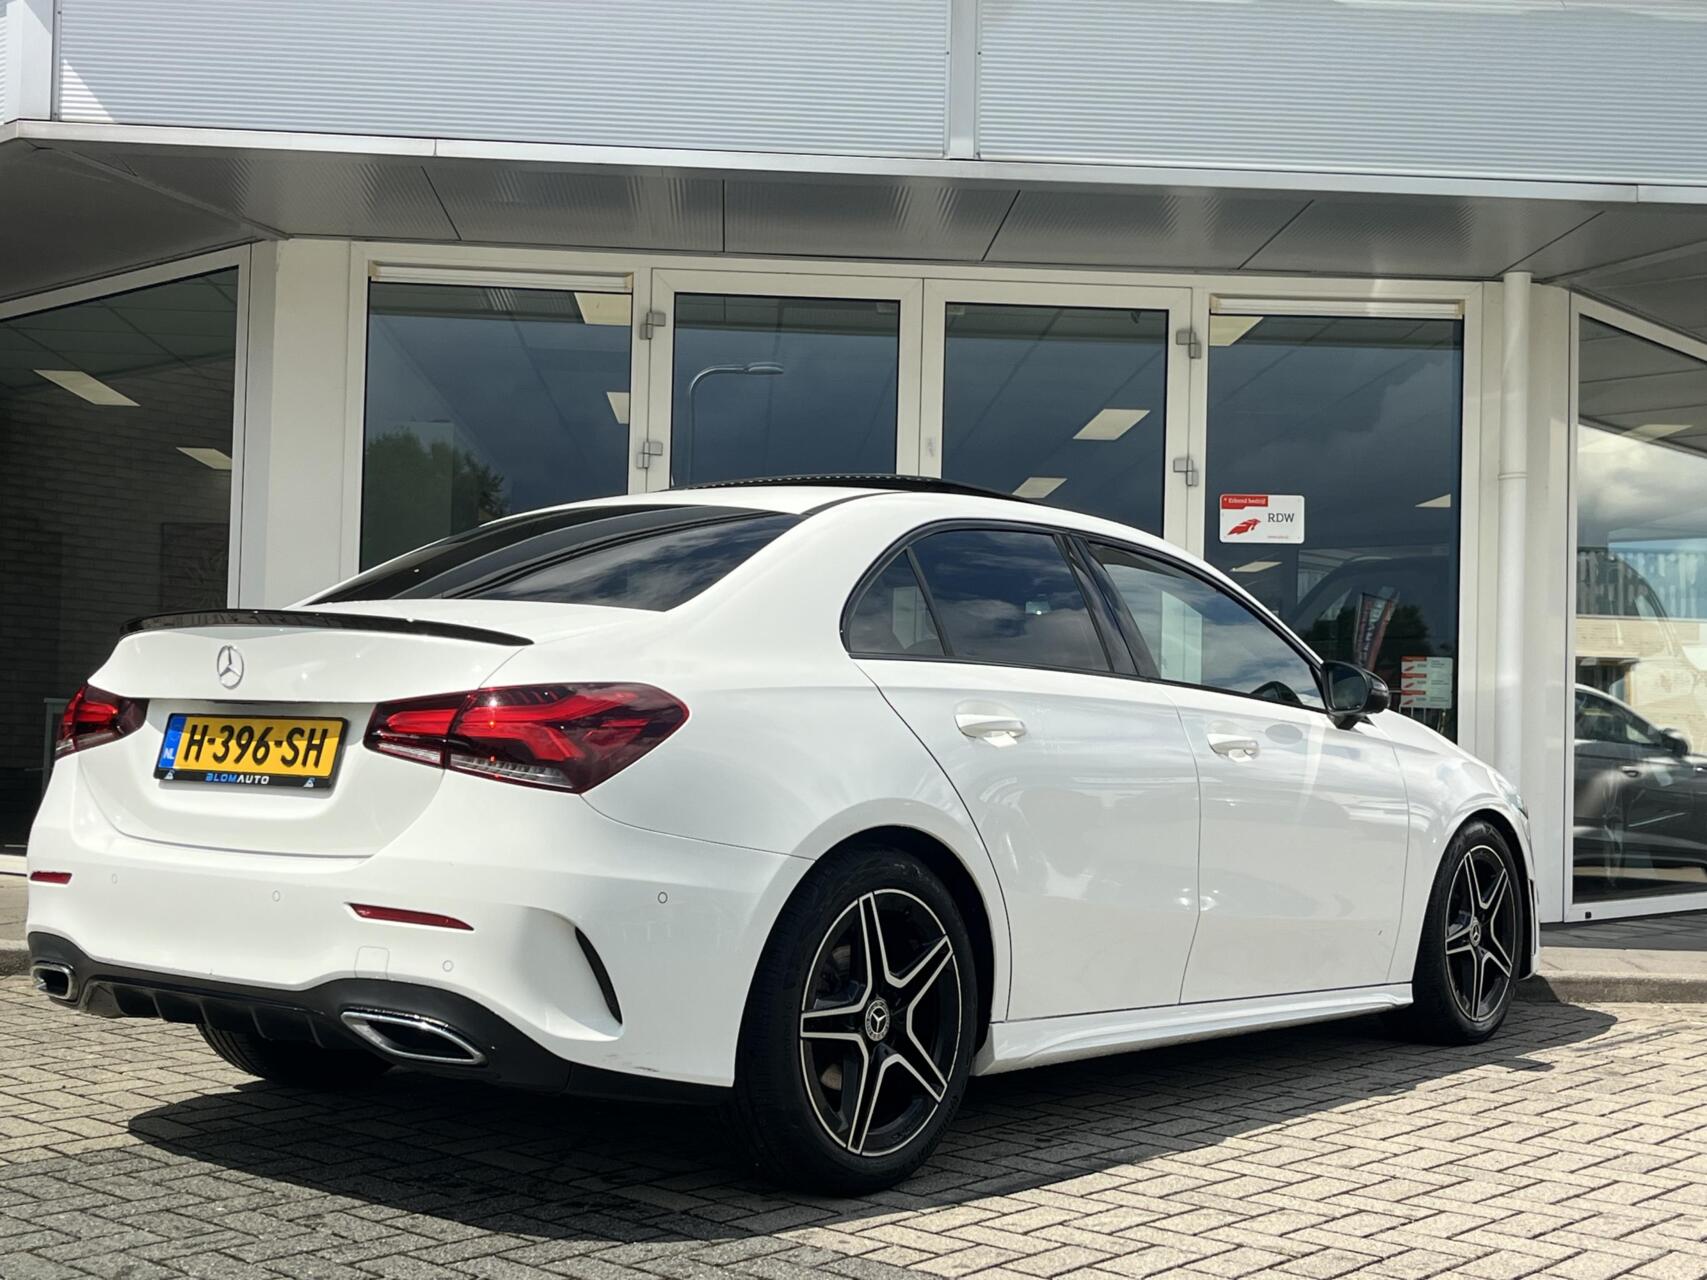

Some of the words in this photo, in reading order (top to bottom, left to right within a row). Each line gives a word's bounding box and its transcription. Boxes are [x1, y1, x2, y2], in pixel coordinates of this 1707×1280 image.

[1268, 513, 1295, 523] RDW
[184, 724, 329, 769] H-396-SH
[163, 748, 175, 760] NL
[206, 772, 270, 785] BLOMAUTO
